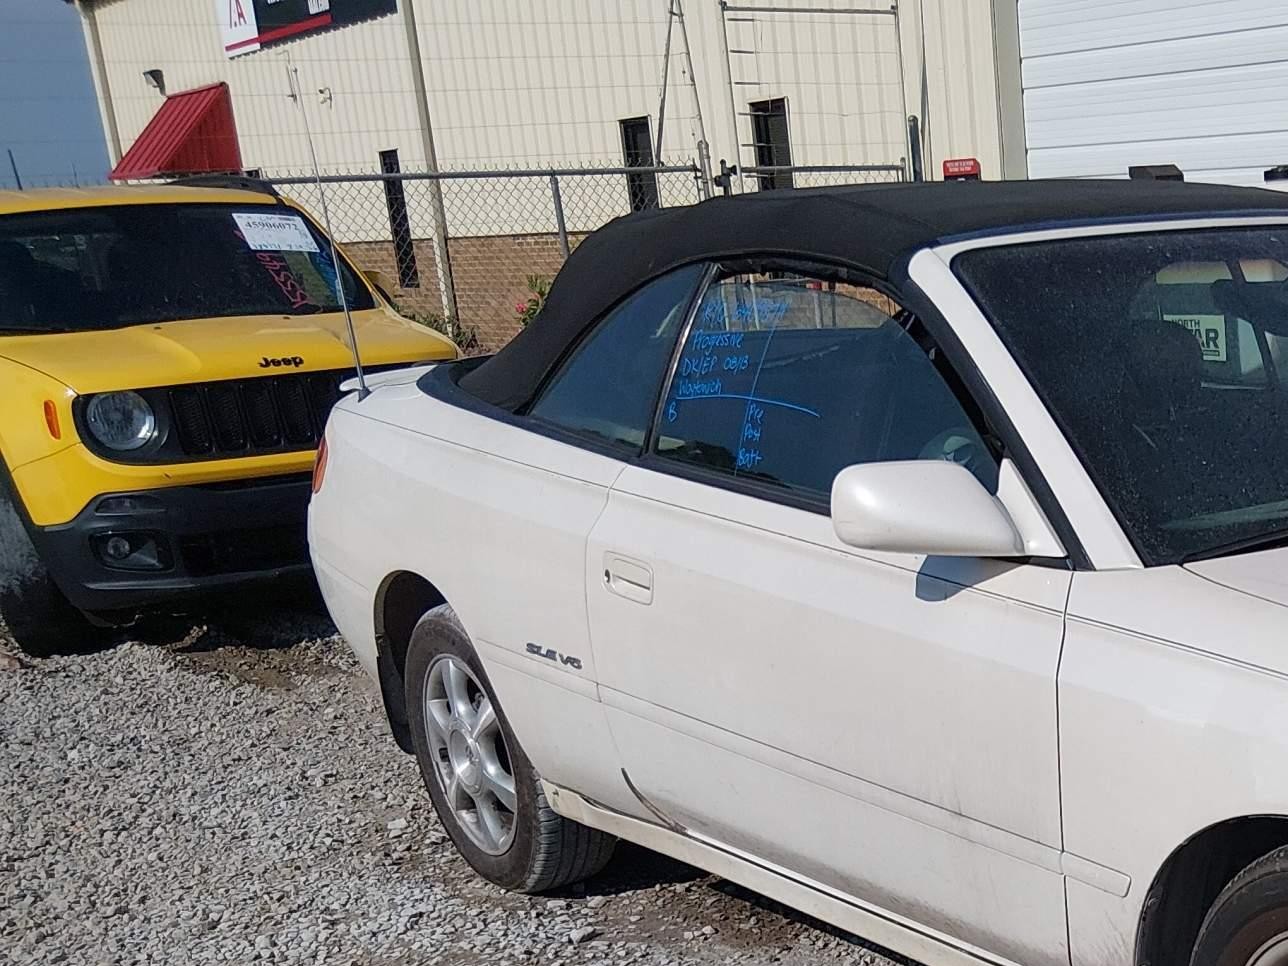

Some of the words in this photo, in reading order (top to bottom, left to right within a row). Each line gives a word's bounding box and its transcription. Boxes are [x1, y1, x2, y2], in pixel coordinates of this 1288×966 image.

[692, 329, 745, 356] Progressive
[257, 355, 305, 369] Jeep
[525, 642, 558, 662] SLE
[558, 652, 583, 670] V6
